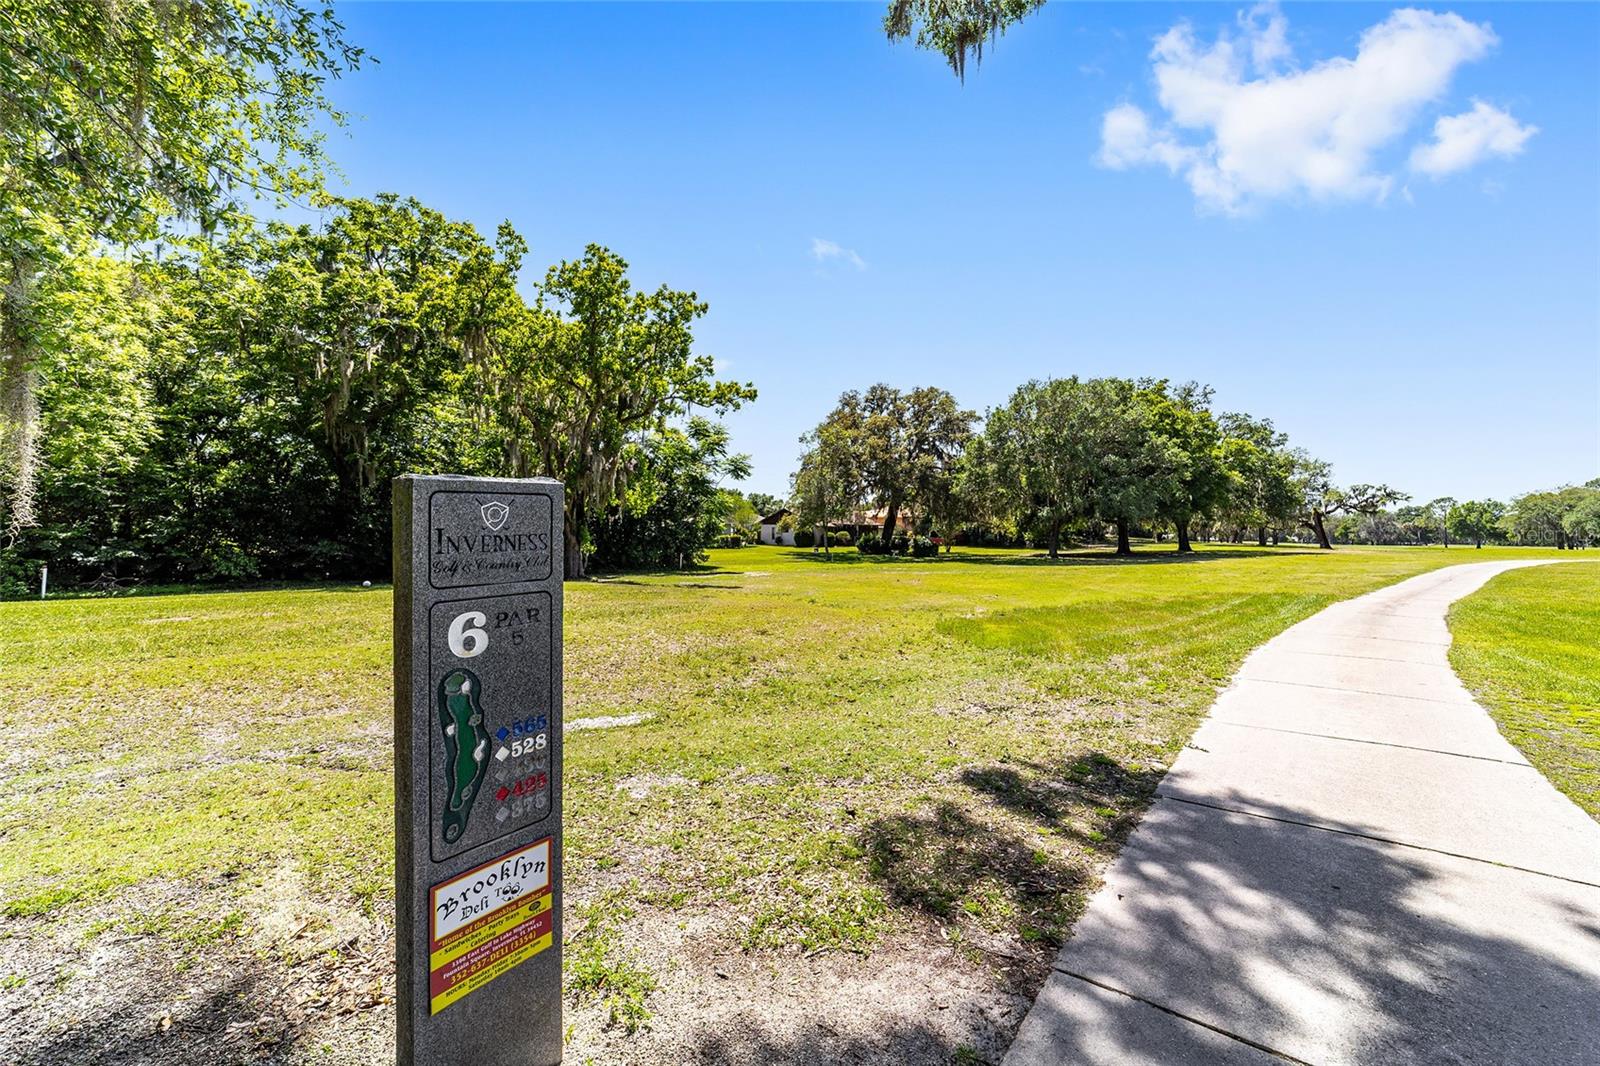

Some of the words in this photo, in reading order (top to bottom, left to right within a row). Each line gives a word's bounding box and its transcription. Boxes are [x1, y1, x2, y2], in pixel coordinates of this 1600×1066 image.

[435, 527, 548, 555] INVERNESS
[433, 560, 459, 577] Golf
[461, 563, 471, 574] &
[474, 558, 523, 571] Country
[495, 608, 540, 629] PAR
[448, 611, 489, 658] 6
[512, 630, 523, 646] 5
[511, 733, 547, 758] 528
[437, 856, 546, 920] Brooklyn
[460, 896, 489, 921] Deli
[465, 925, 473, 934] of
[474, 921, 486, 929] the
[488, 919, 504, 931] Party
[471, 931, 496, 947] Catering
[500, 931, 512, 941] Lake
[511, 931, 536, 950] (3354)
[443, 961, 469, 979] Fountain
